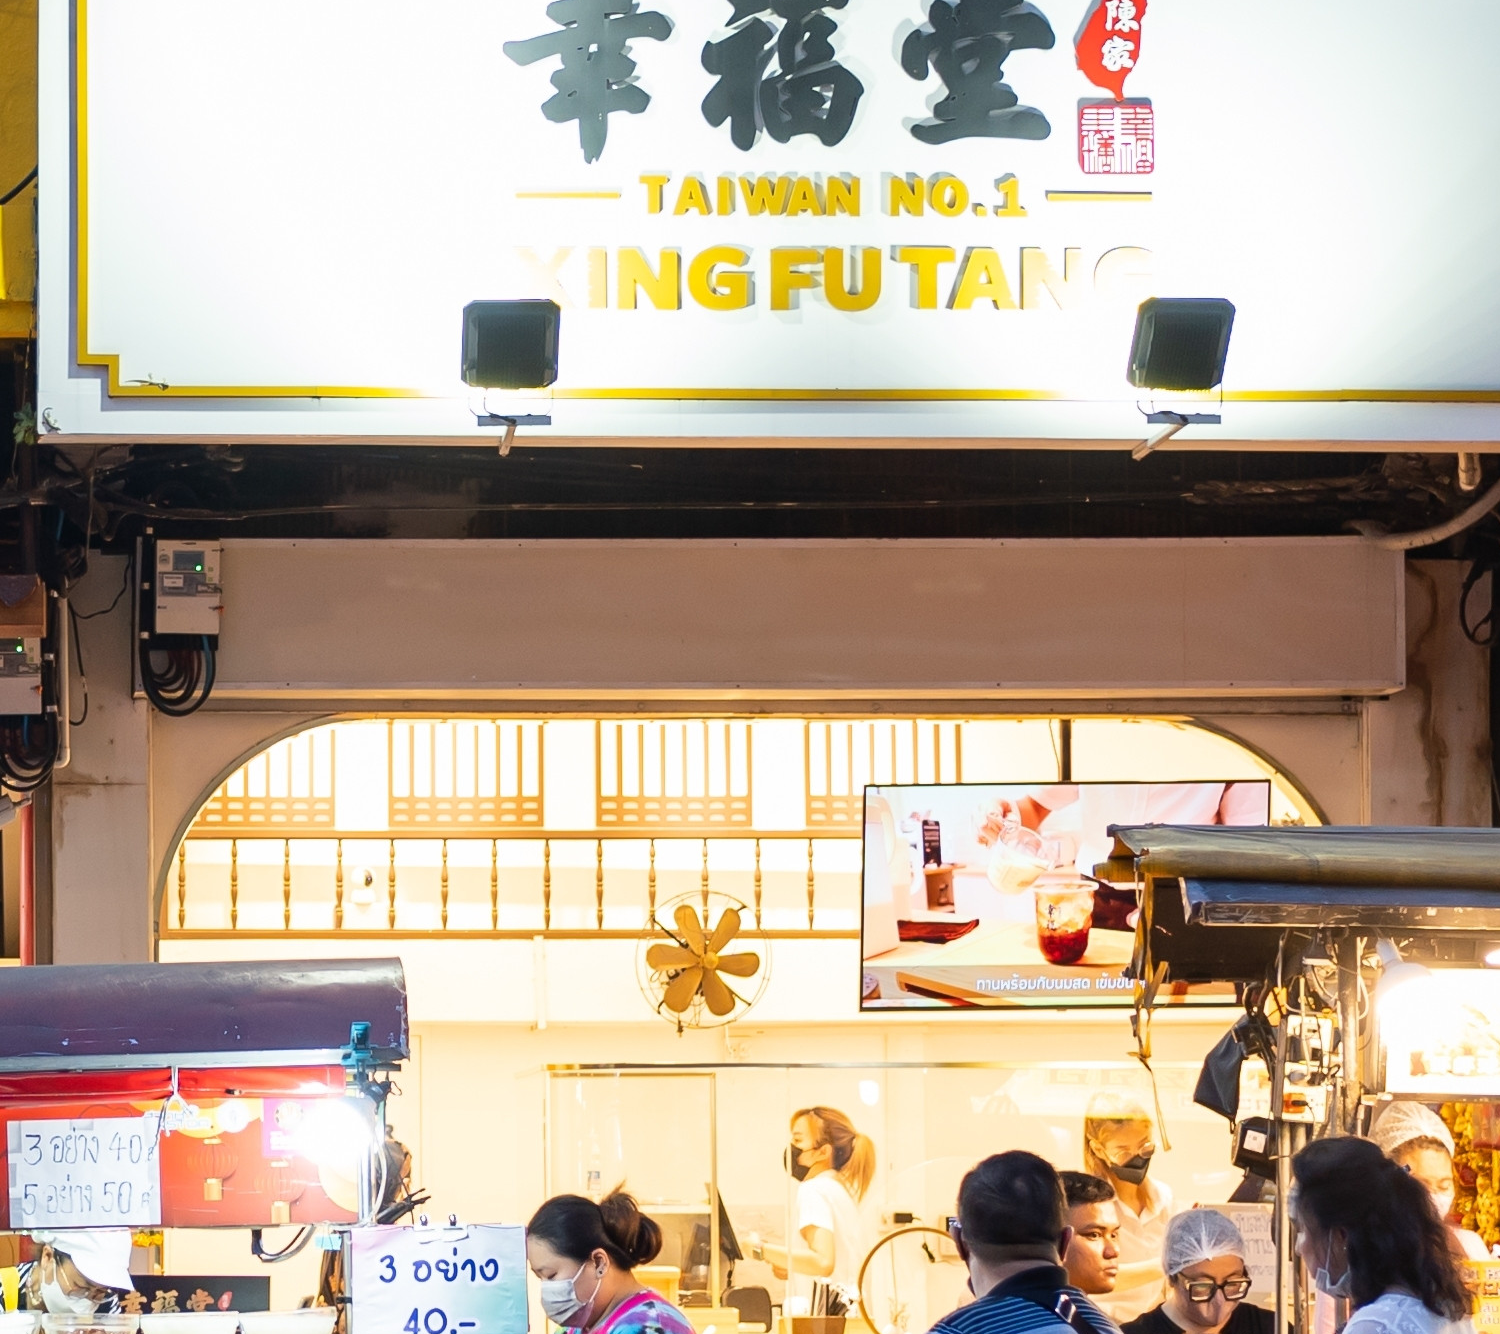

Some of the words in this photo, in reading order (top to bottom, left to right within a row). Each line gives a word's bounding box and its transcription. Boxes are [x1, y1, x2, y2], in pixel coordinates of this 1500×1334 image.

[640, 174, 861, 218] TAIWAN
[888, 174, 1028, 218] NO.1
[24, 1134, 43, 1165] 3
[50, 1128, 100, 1165] อย่าง
[108, 1132, 144, 1163] 40
[22, 1183, 38, 1215] 5
[100, 1181, 133, 1215] 50
[379, 1255, 397, 1283] 3
[412, 1247, 499, 1283] อย่าง
